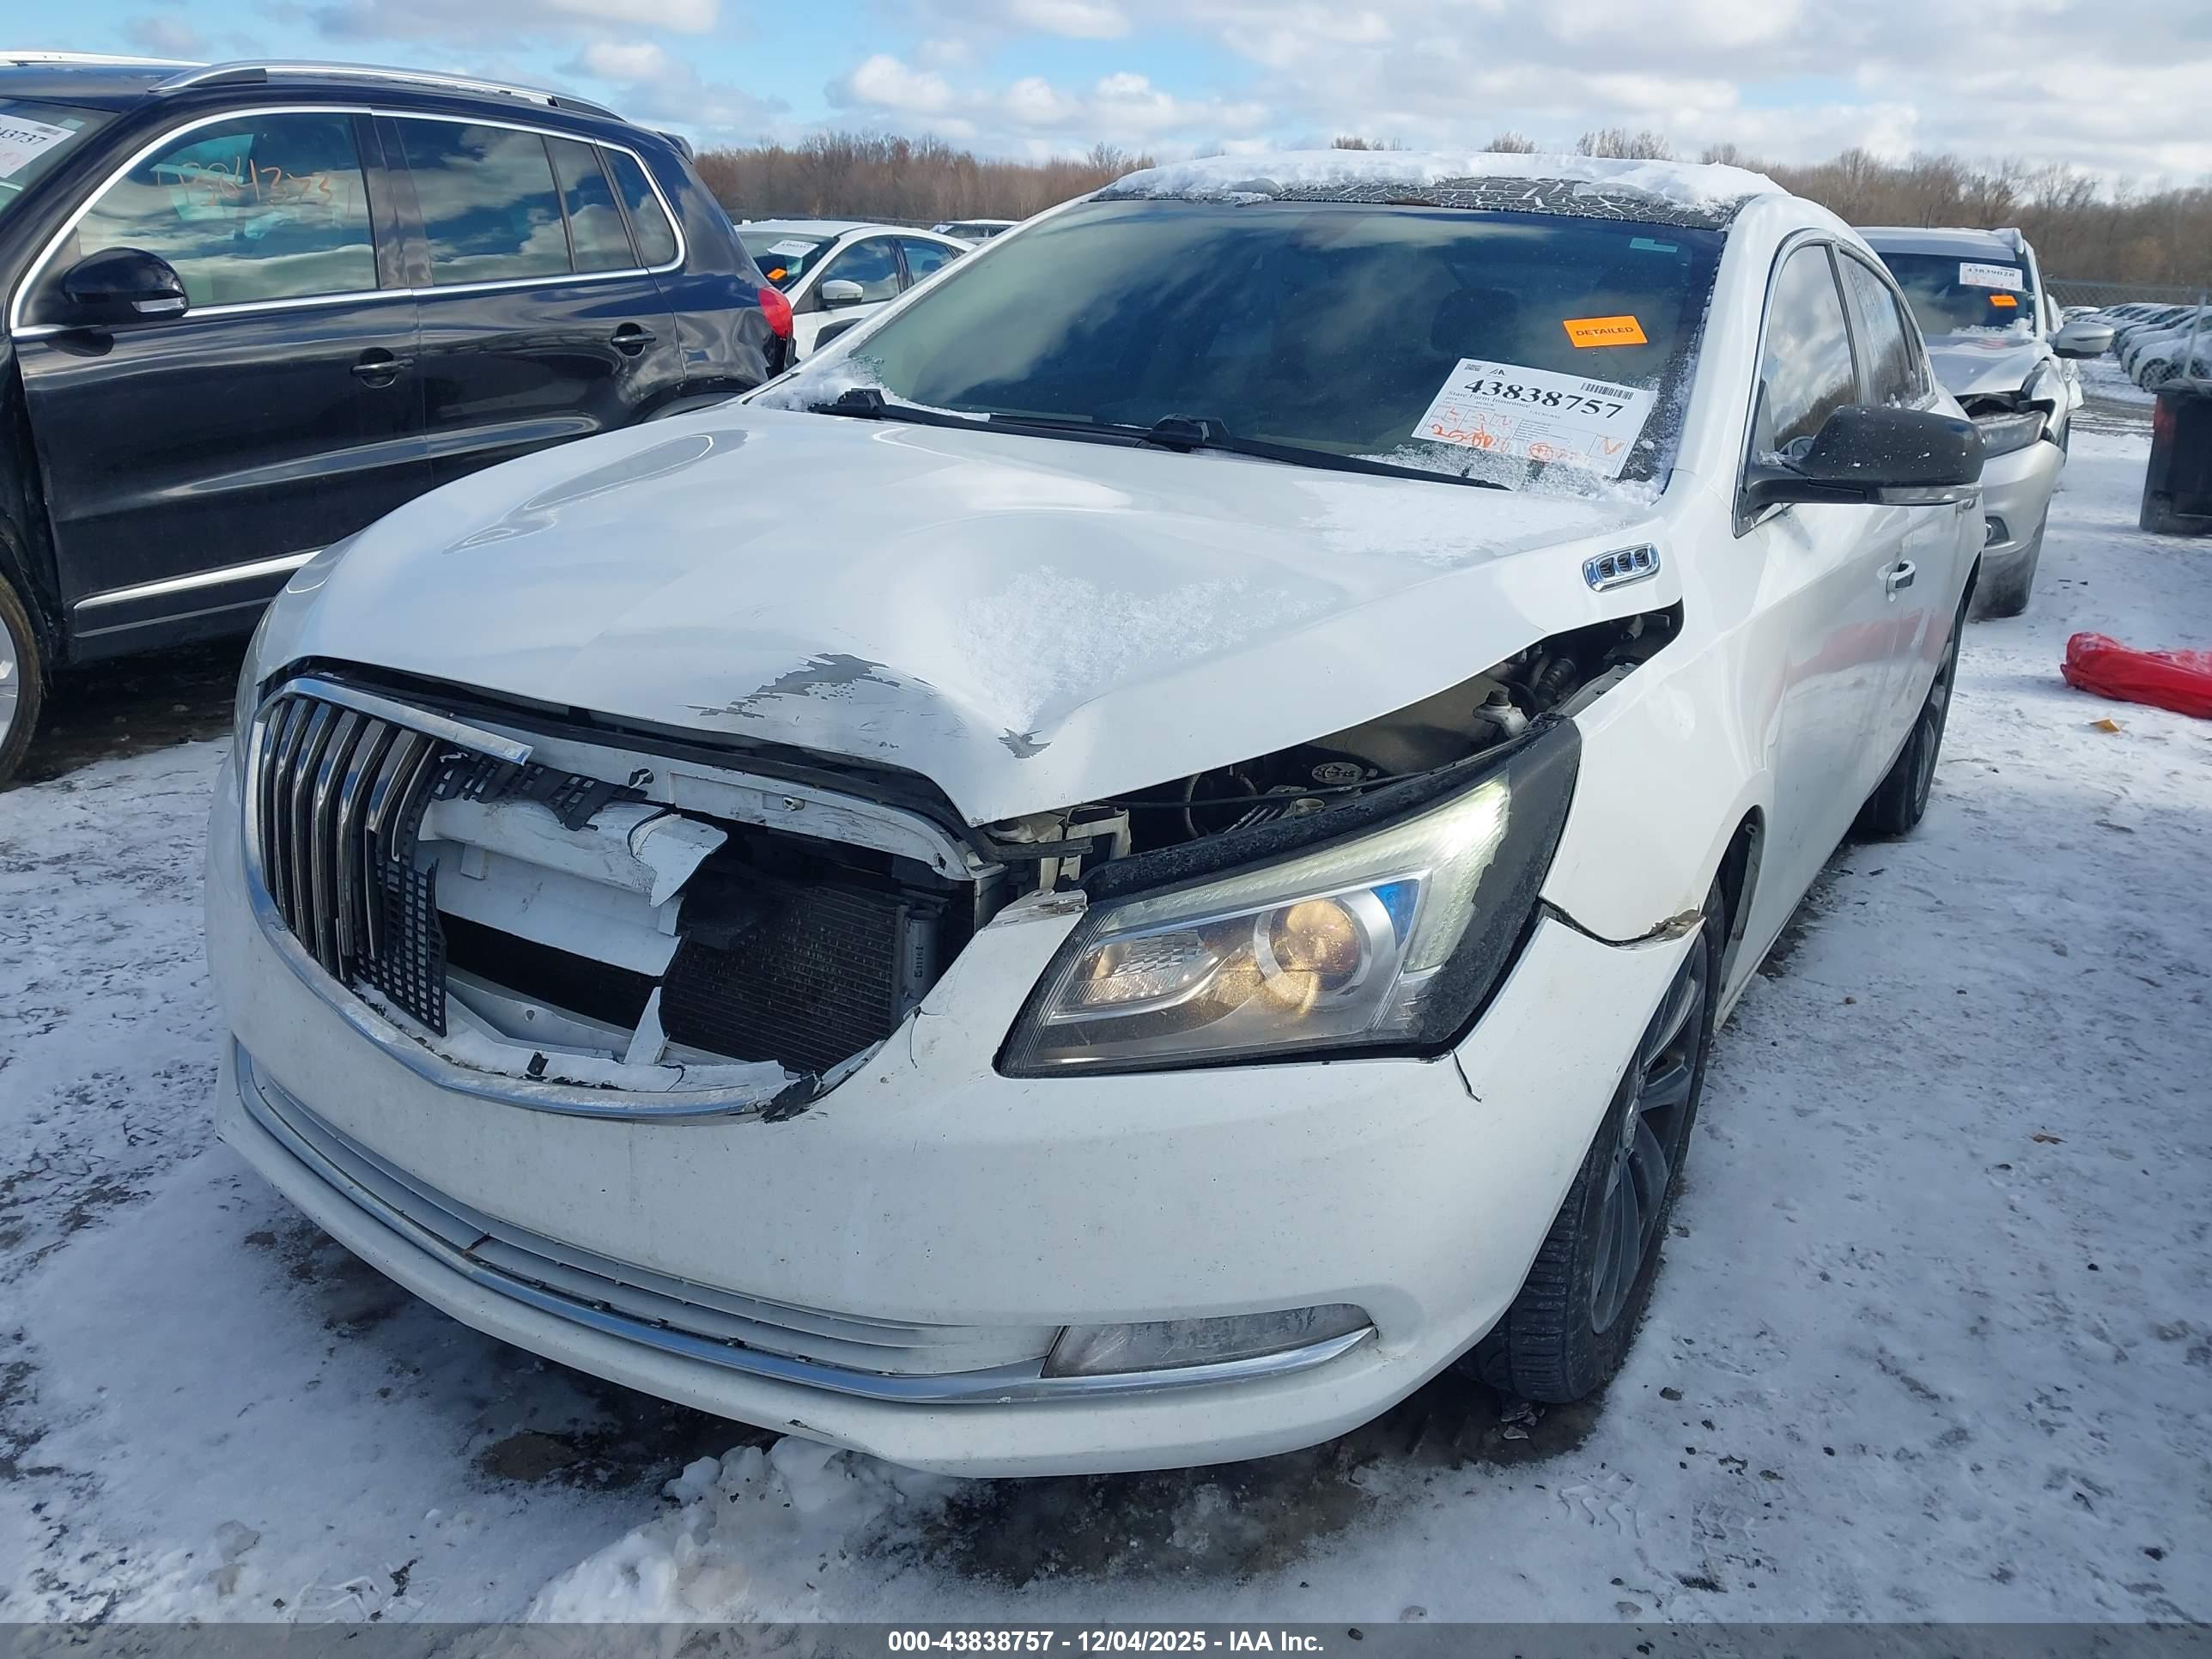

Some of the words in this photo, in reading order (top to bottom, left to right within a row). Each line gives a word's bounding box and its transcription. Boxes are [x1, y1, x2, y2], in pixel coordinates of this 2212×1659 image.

[1575, 326, 1635, 337] DETAILED
[1447, 390, 1468, 398] State
[1469, 393, 1490, 402] Farm
[1492, 397, 1531, 409] Insurance
[1464, 379, 1624, 418] 43838757
